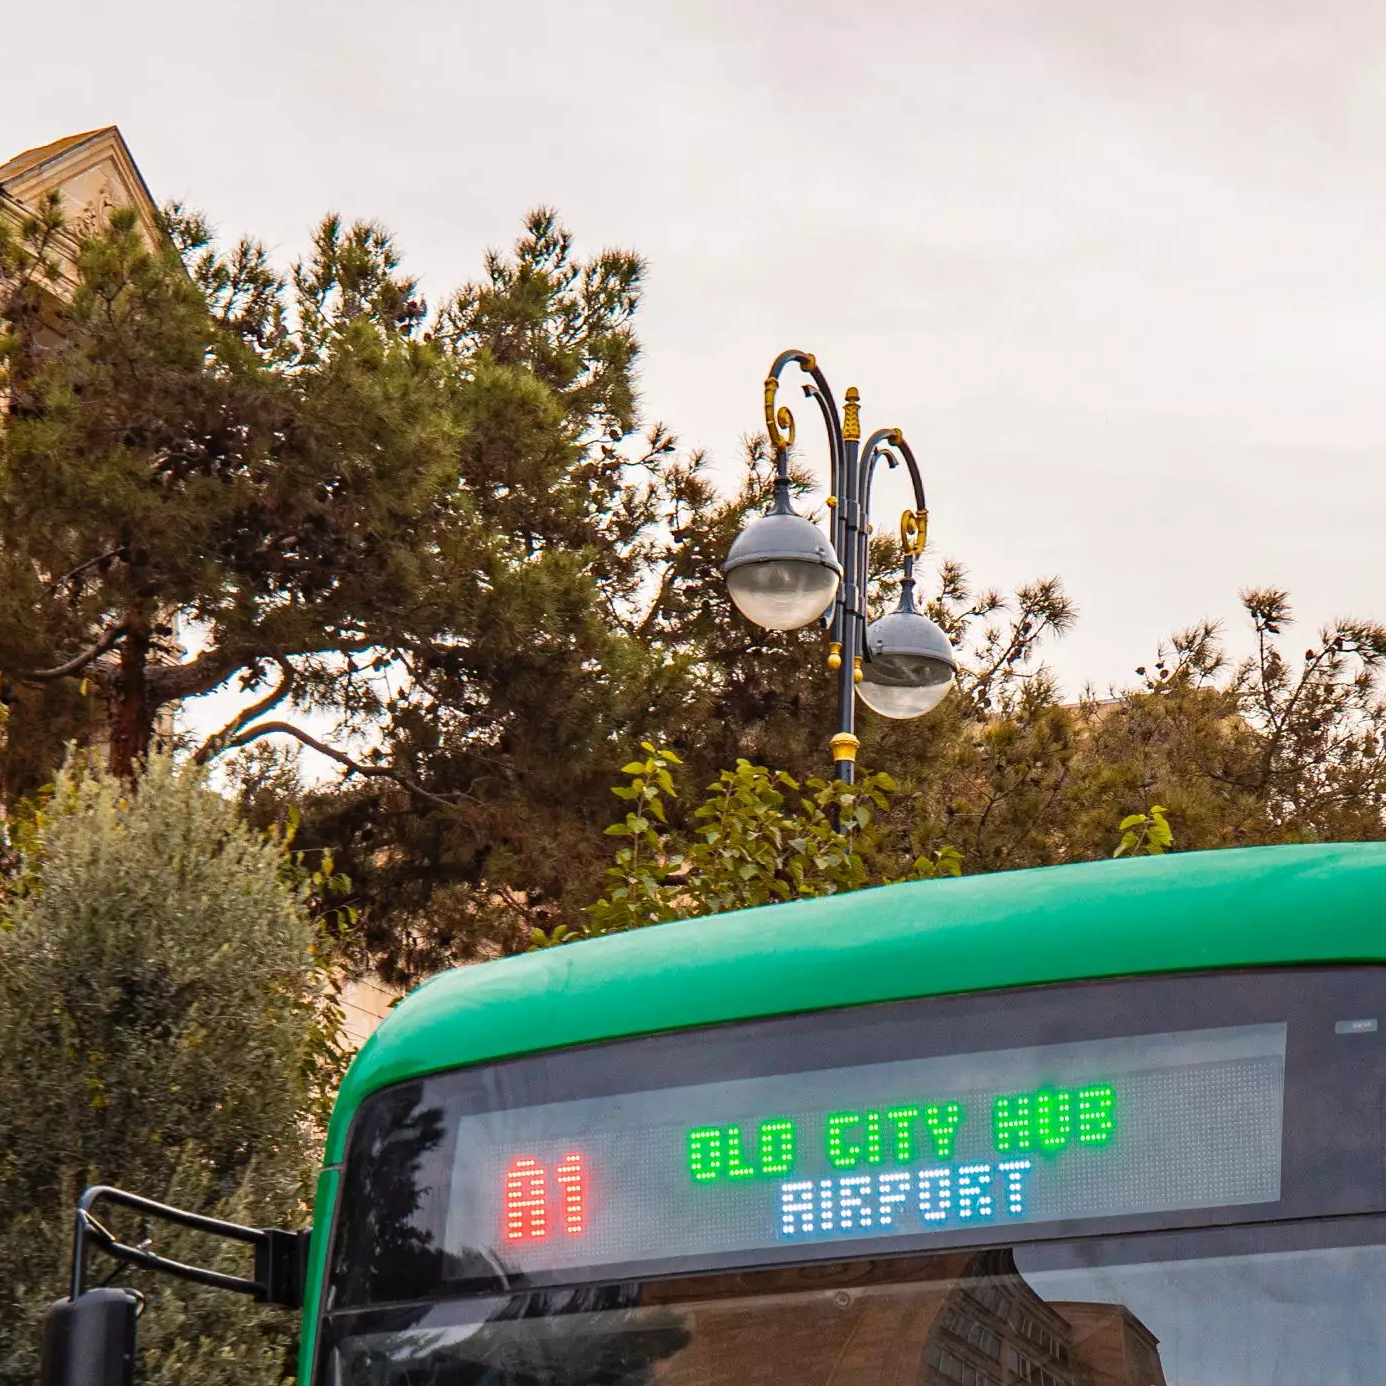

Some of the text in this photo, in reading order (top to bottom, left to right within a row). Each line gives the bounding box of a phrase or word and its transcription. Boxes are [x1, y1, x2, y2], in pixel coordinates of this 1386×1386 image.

[687, 1086, 1117, 1181] OLD CITY HUB
[503, 1154, 586, 1242] A1
[779, 1159, 1032, 1236] AIRPORT
